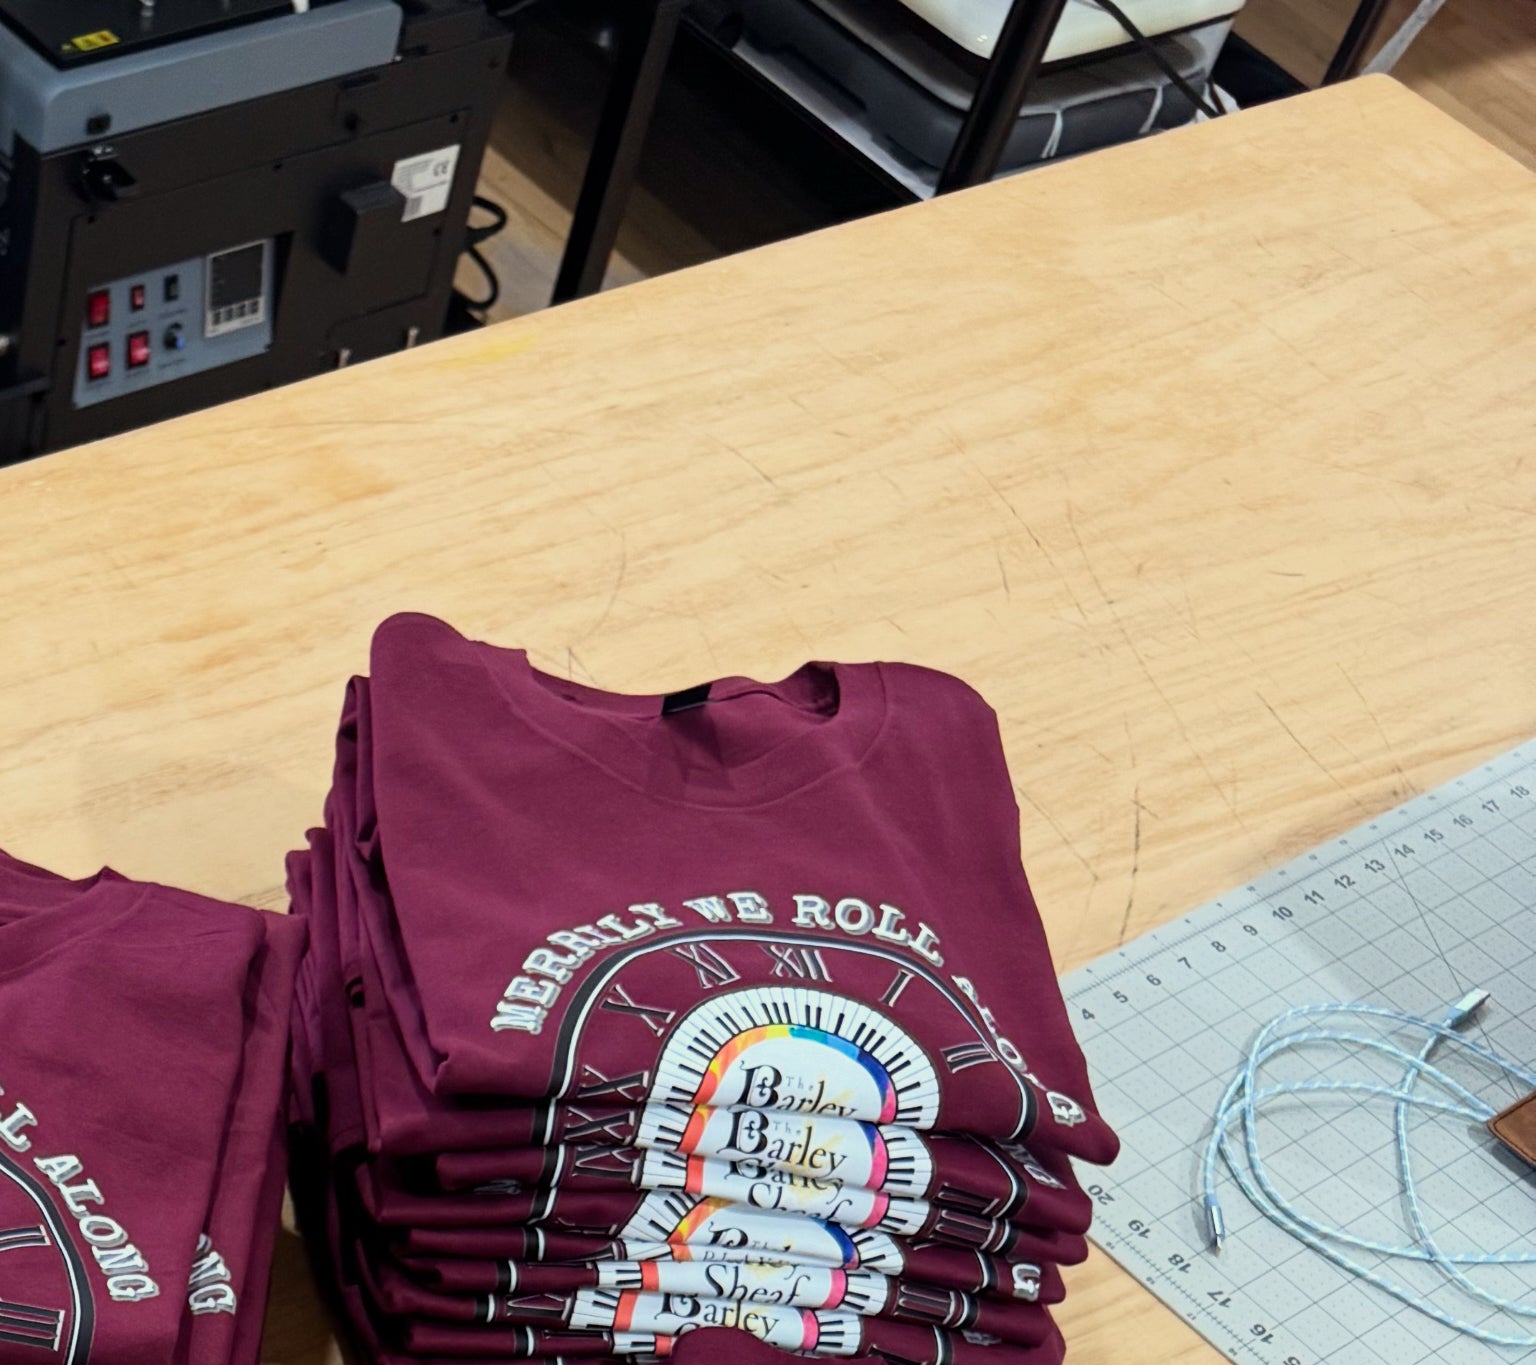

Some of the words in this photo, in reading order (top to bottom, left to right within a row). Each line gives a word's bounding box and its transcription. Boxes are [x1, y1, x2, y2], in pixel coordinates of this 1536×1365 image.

[1082, 1008, 1095, 1020] 4
[1113, 991, 1129, 1004] 5
[1146, 974, 1161, 986] 6
[1177, 957, 1192, 969] 7
[1211, 940, 1226, 952] 8
[1242, 925, 1258, 936] 9
[1272, 906, 1293, 921] 10
[1304, 890, 1325, 905] 11
[1334, 874, 1356, 889] 12
[1365, 859, 1385, 873] 13
[1394, 844, 1415, 858] 14
[1424, 829, 1444, 843] 15
[1453, 814, 1473, 828] 16
[1482, 799, 1500, 813] 17
[1510, 785, 1530, 799] 18
[490, 902, 683, 1034] MERRILY
[682, 892, 774, 924] WE
[792, 894, 945, 968] ROLL
[716, 1105, 848, 1178] Barley
[1088, 1184, 1115, 1206] 20
[34, 1153, 160, 1301] ALONG
[1128, 1219, 1153, 1240] 19
[1167, 1253, 1193, 1275] 18
[1207, 1290, 1233, 1309] 17
[1250, 1323, 1274, 1345] 16
